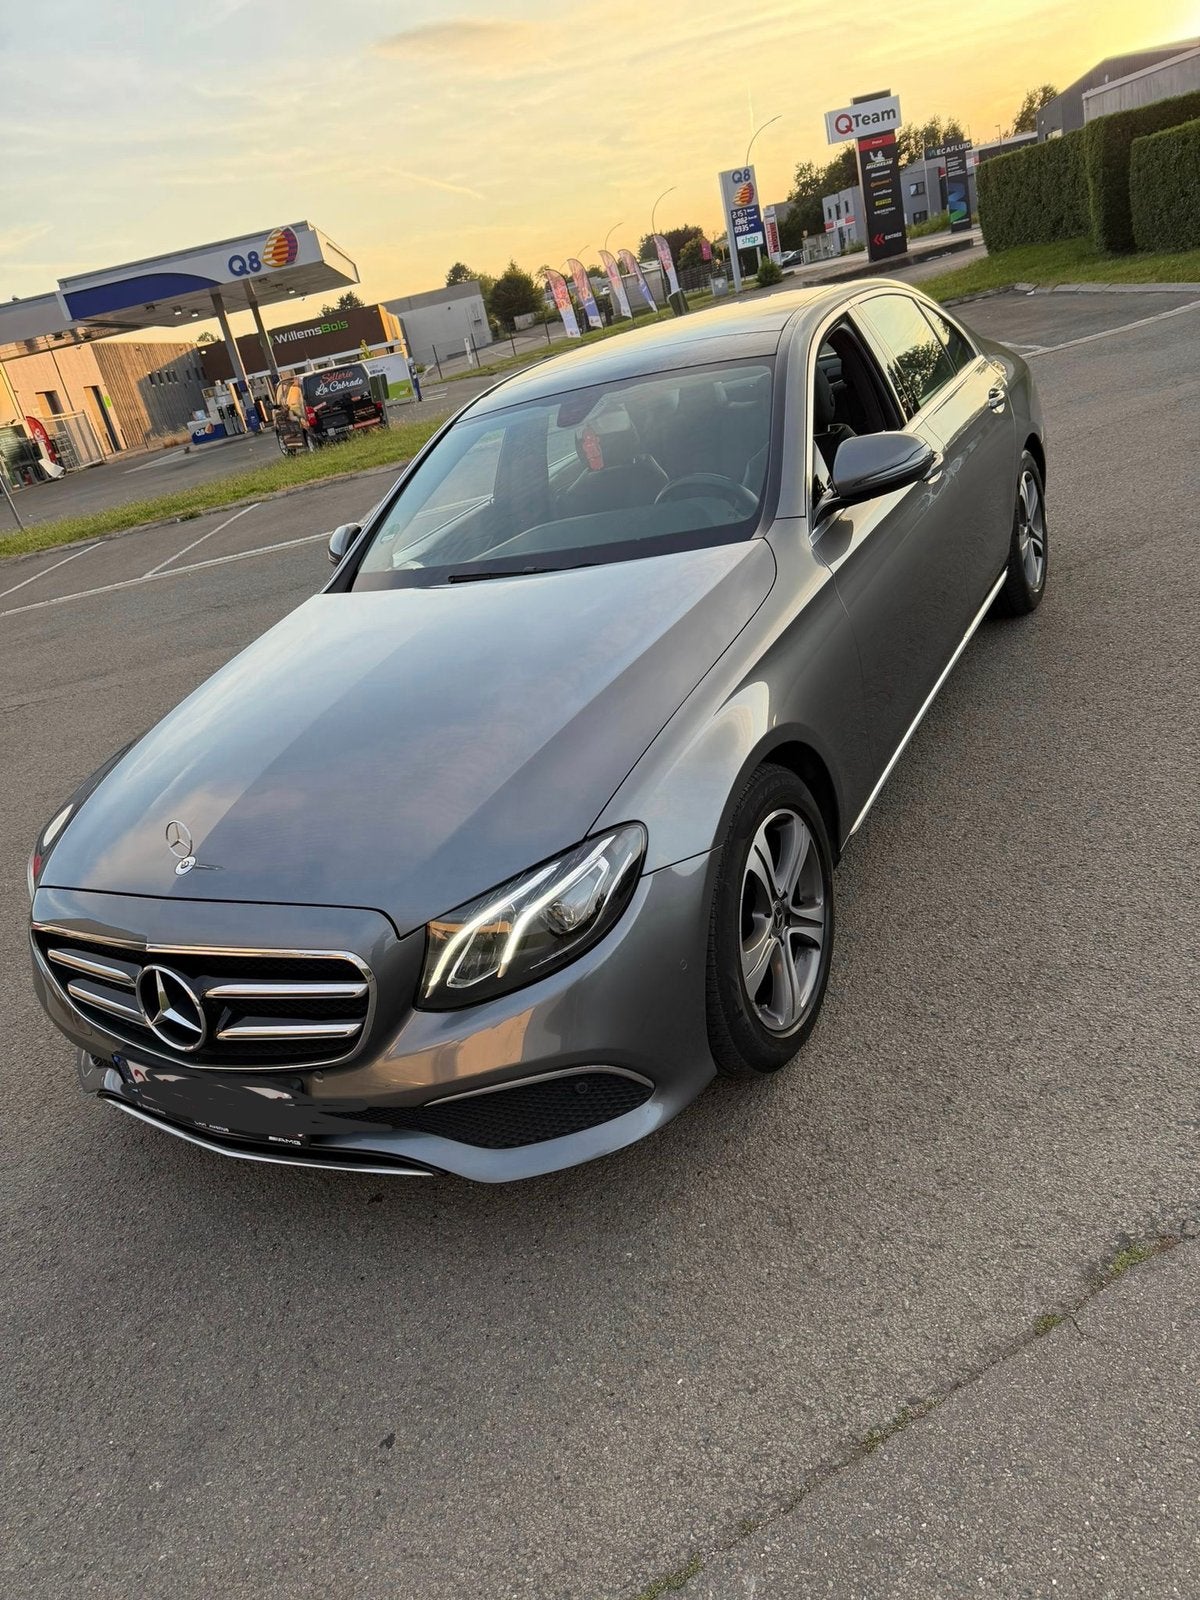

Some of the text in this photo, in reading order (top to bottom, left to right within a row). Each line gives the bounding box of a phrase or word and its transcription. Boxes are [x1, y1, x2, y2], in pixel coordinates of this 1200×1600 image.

[835, 108, 896, 135] QTeam
[732, 168, 751, 183] Q8
[228, 251, 262, 276] Q8
[274, 320, 349, 344] WillemsBois
[320, 370, 353, 385] Sellerie
[315, 383, 328, 396] La
